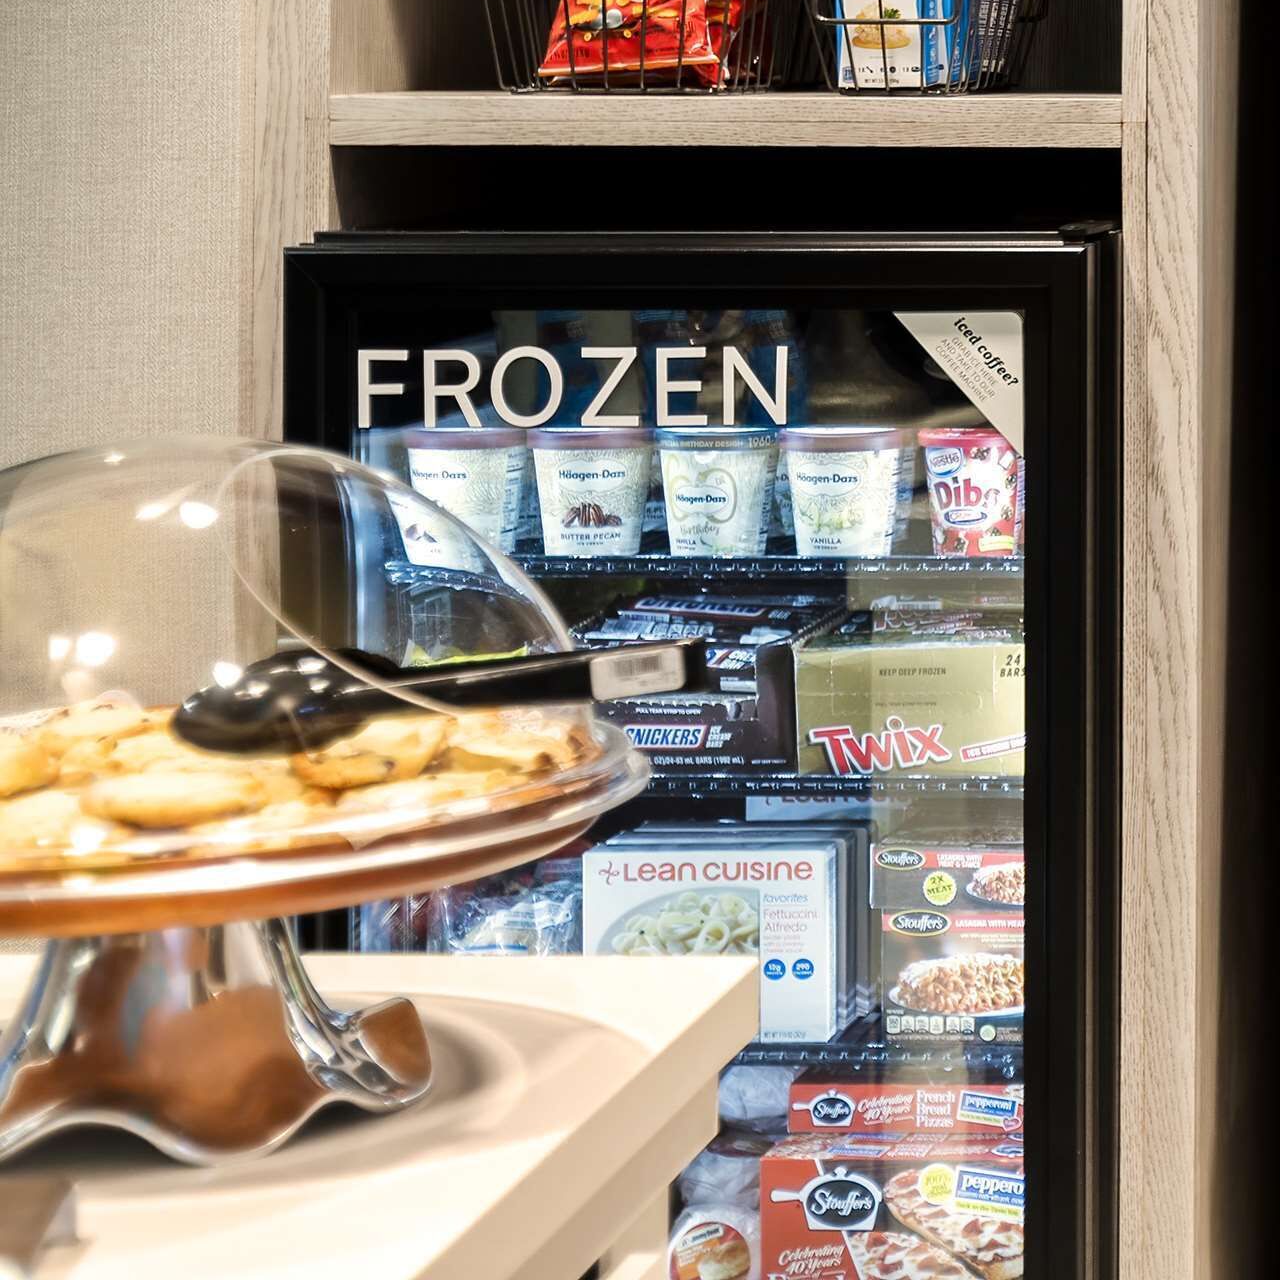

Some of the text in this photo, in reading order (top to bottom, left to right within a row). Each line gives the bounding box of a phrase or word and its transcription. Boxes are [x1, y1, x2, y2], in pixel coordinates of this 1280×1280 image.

[951, 336, 997, 387] GRAB ICE HERE
[953, 316, 1019, 391] iced coffee?
[935, 345, 987, 404] COFFEE MACHINE
[940, 338, 996, 399] AND TAKE TO OUR
[356, 344, 788, 428] FROZEN
[558, 469, 626, 482] Häagen-Dazs
[796, 471, 859, 484] Häagen-Dazs
[560, 531, 621, 540] BUTTER PECAN
[810, 537, 842, 545] VANILLA
[1006, 654, 1022, 666] 24
[879, 668, 947, 677] KEEP DEEP FROZEN
[626, 726, 702, 746] SNICKERS
[810, 716, 952, 777] Twix
[880, 853, 920, 866] Stouffer's
[930, 876, 944, 885] 2X
[926, 884, 953, 896] MEAT
[763, 893, 809, 904] favorites
[763, 908, 818, 920] Fettuccini
[763, 921, 807, 933] Alfredo
[896, 915, 944, 931] Stouffer's
[857, 1093, 914, 1113] Celebrating
[915, 1088, 956, 1104] French
[965, 1093, 1013, 1111] pepperoni
[863, 1103, 912, 1121] 40 Years
[915, 1103, 952, 1116] Bread
[915, 1115, 955, 1128] Pizzas
[961, 1174, 1024, 1195] peppero
[811, 1189, 873, 1216] Stouffer's
[778, 1244, 845, 1266] Celebrating
[785, 1257, 841, 1275] 40 Years
